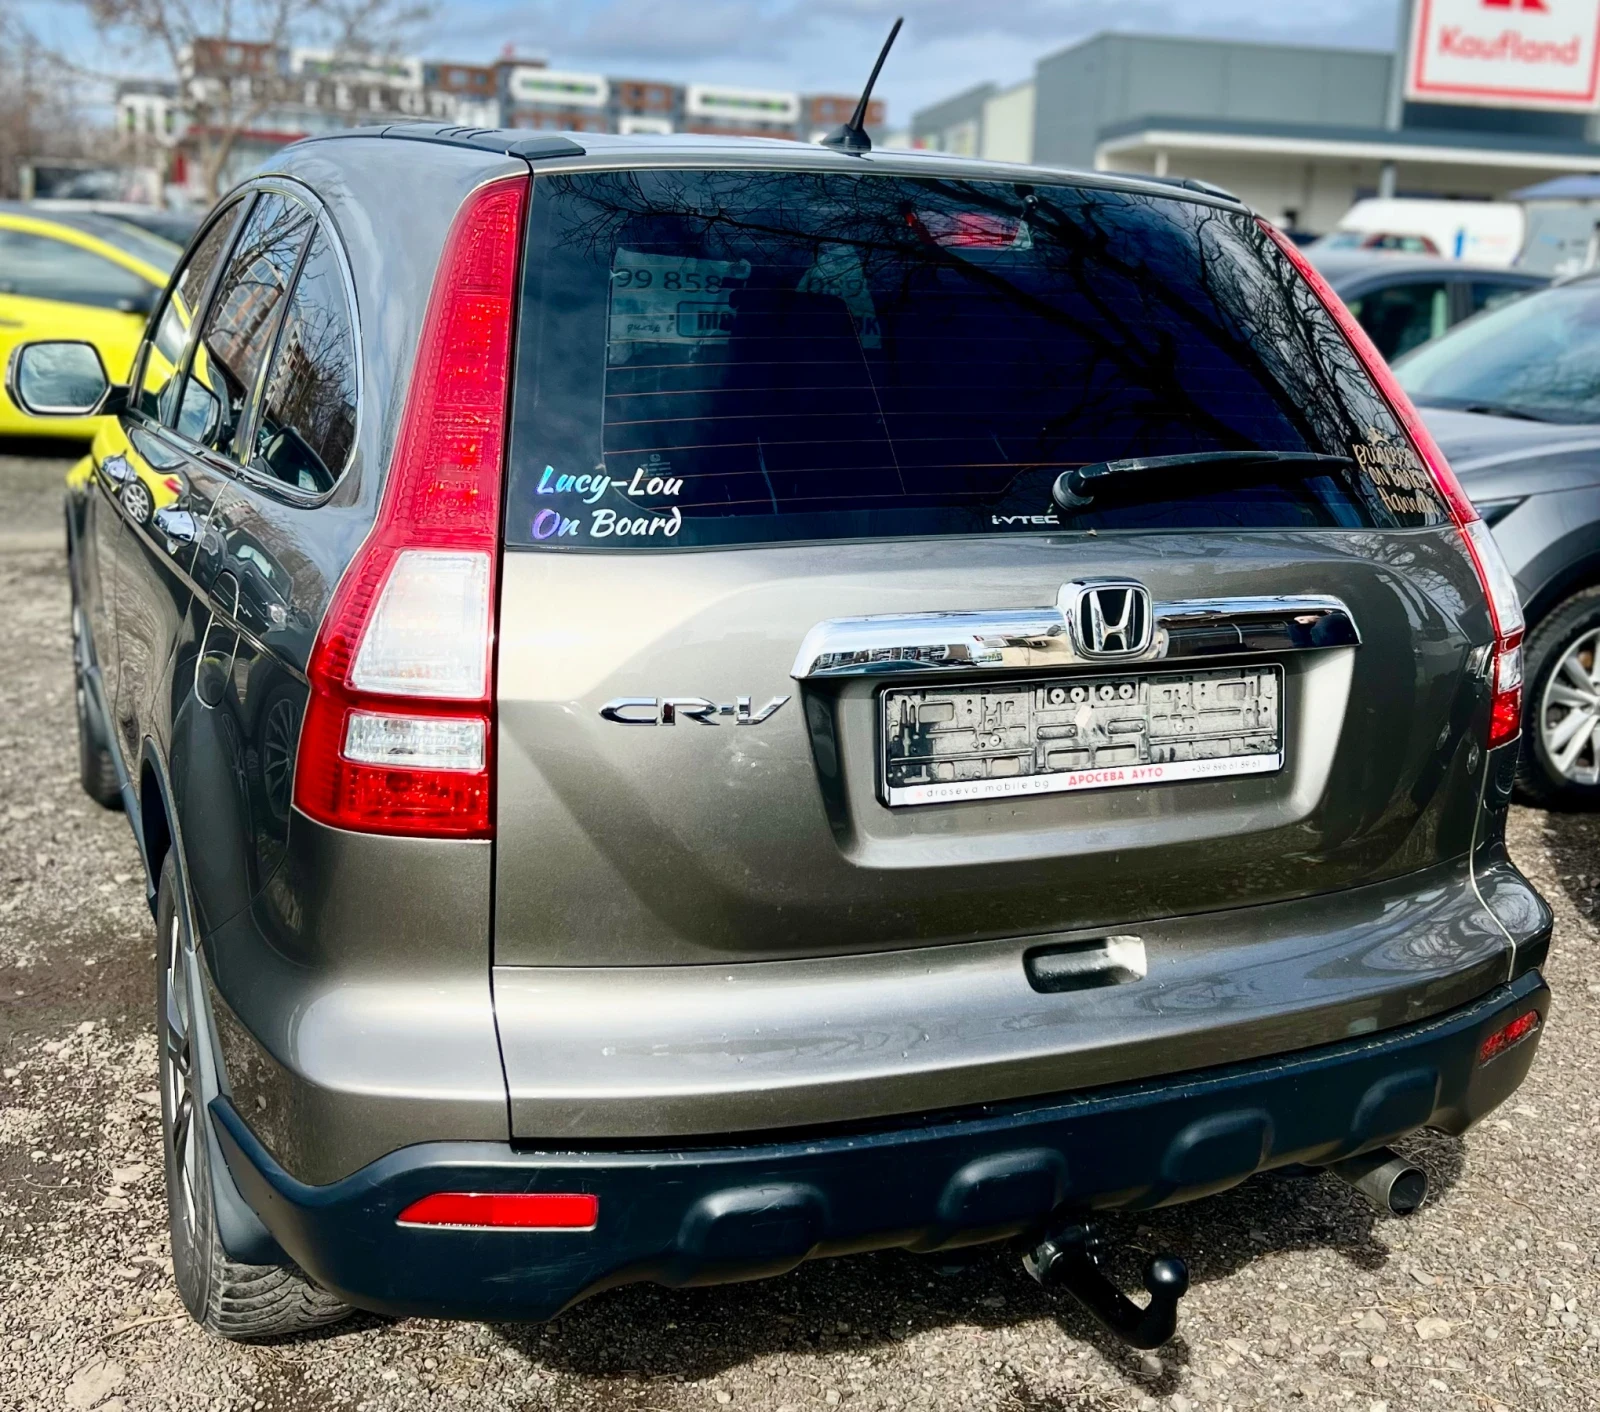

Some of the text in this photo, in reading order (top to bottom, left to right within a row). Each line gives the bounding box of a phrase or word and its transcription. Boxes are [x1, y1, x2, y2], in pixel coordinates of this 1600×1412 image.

[1438, 24, 1581, 65] Kaufland
[536, 465, 684, 504] Lucy-Lou
[1368, 466, 1390, 486] ON
[531, 506, 682, 540] On Board
[598, 695, 792, 726] CR-V
[1068, 767, 1163, 786] ДРОСЕВА АУТО
